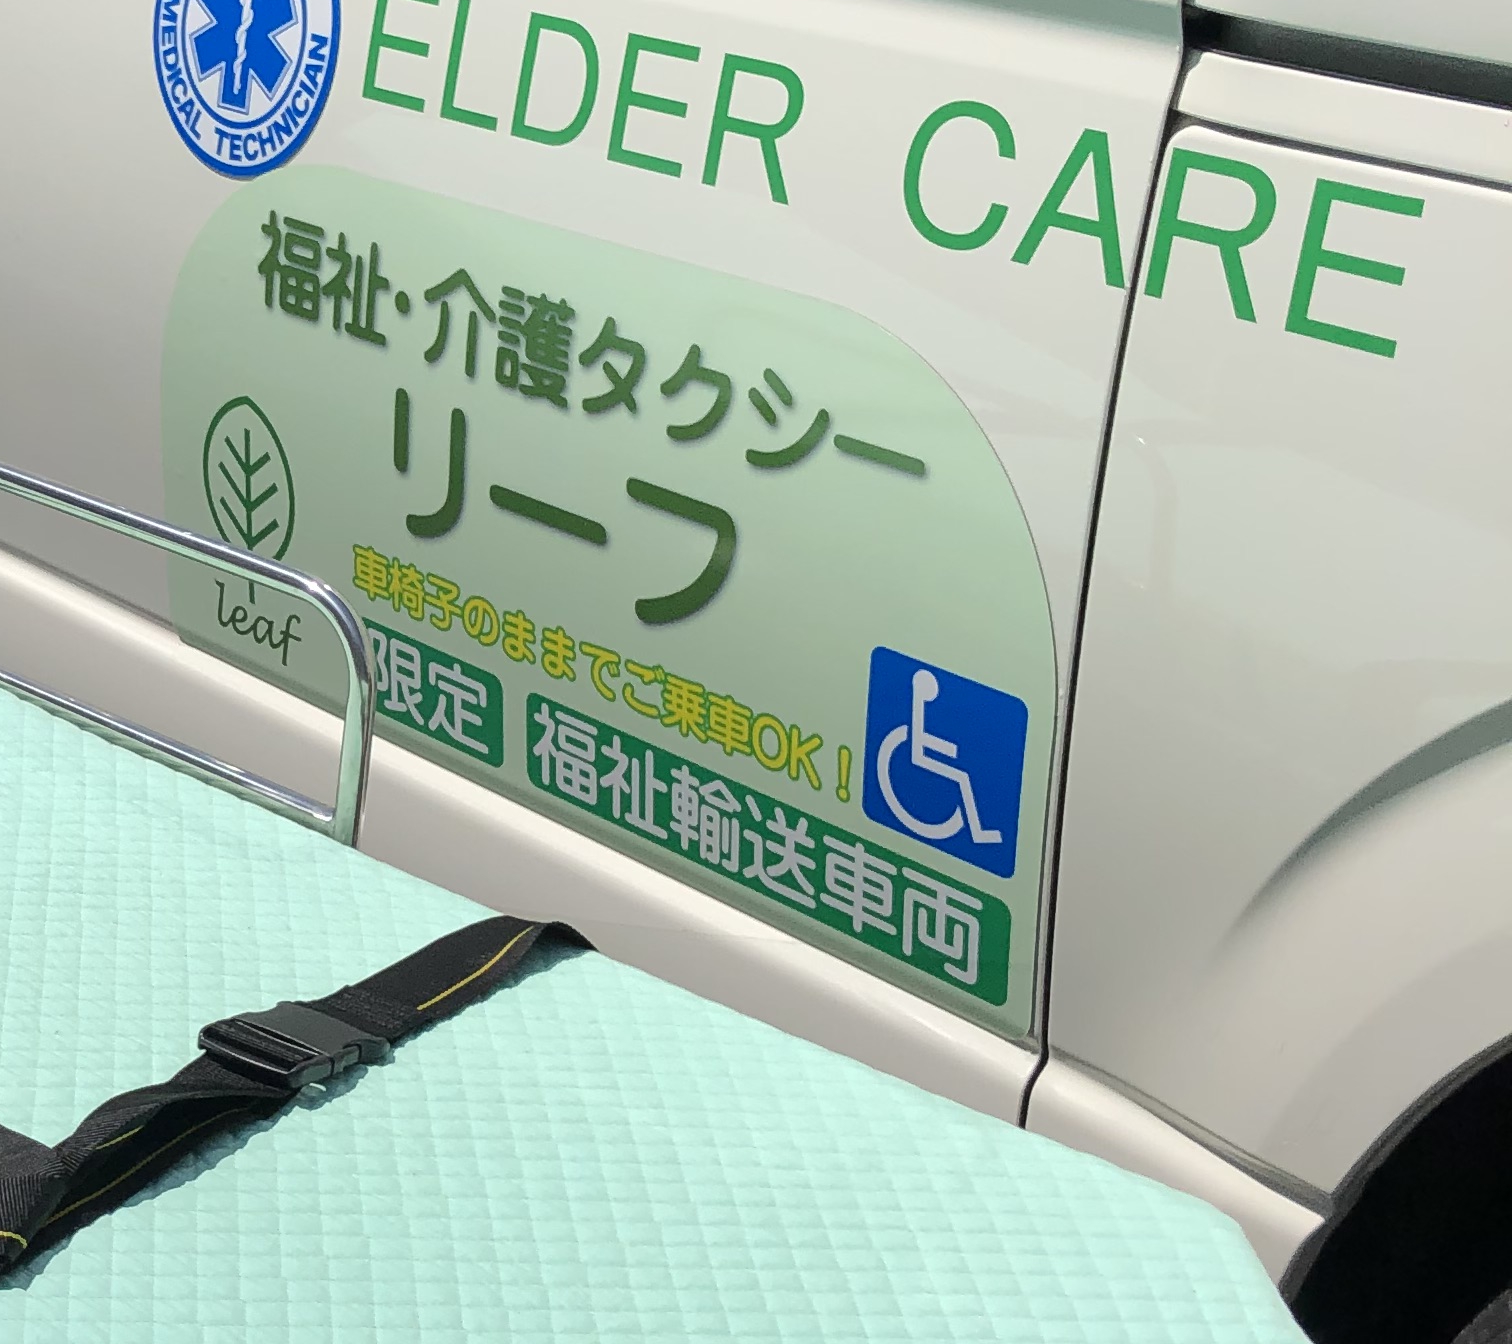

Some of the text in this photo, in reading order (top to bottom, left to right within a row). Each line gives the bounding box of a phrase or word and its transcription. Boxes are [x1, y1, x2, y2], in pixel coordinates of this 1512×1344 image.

[213, 33, 329, 163] TECHNICIAN
[257, 209, 927, 476] 福祉・介護タクシー
[902, 99, 1427, 360] CARE
[213, 577, 303, 667] leaf
[391, 387, 739, 626] リーフ
[367, 626, 985, 985] 限定 福祉輸送車両
